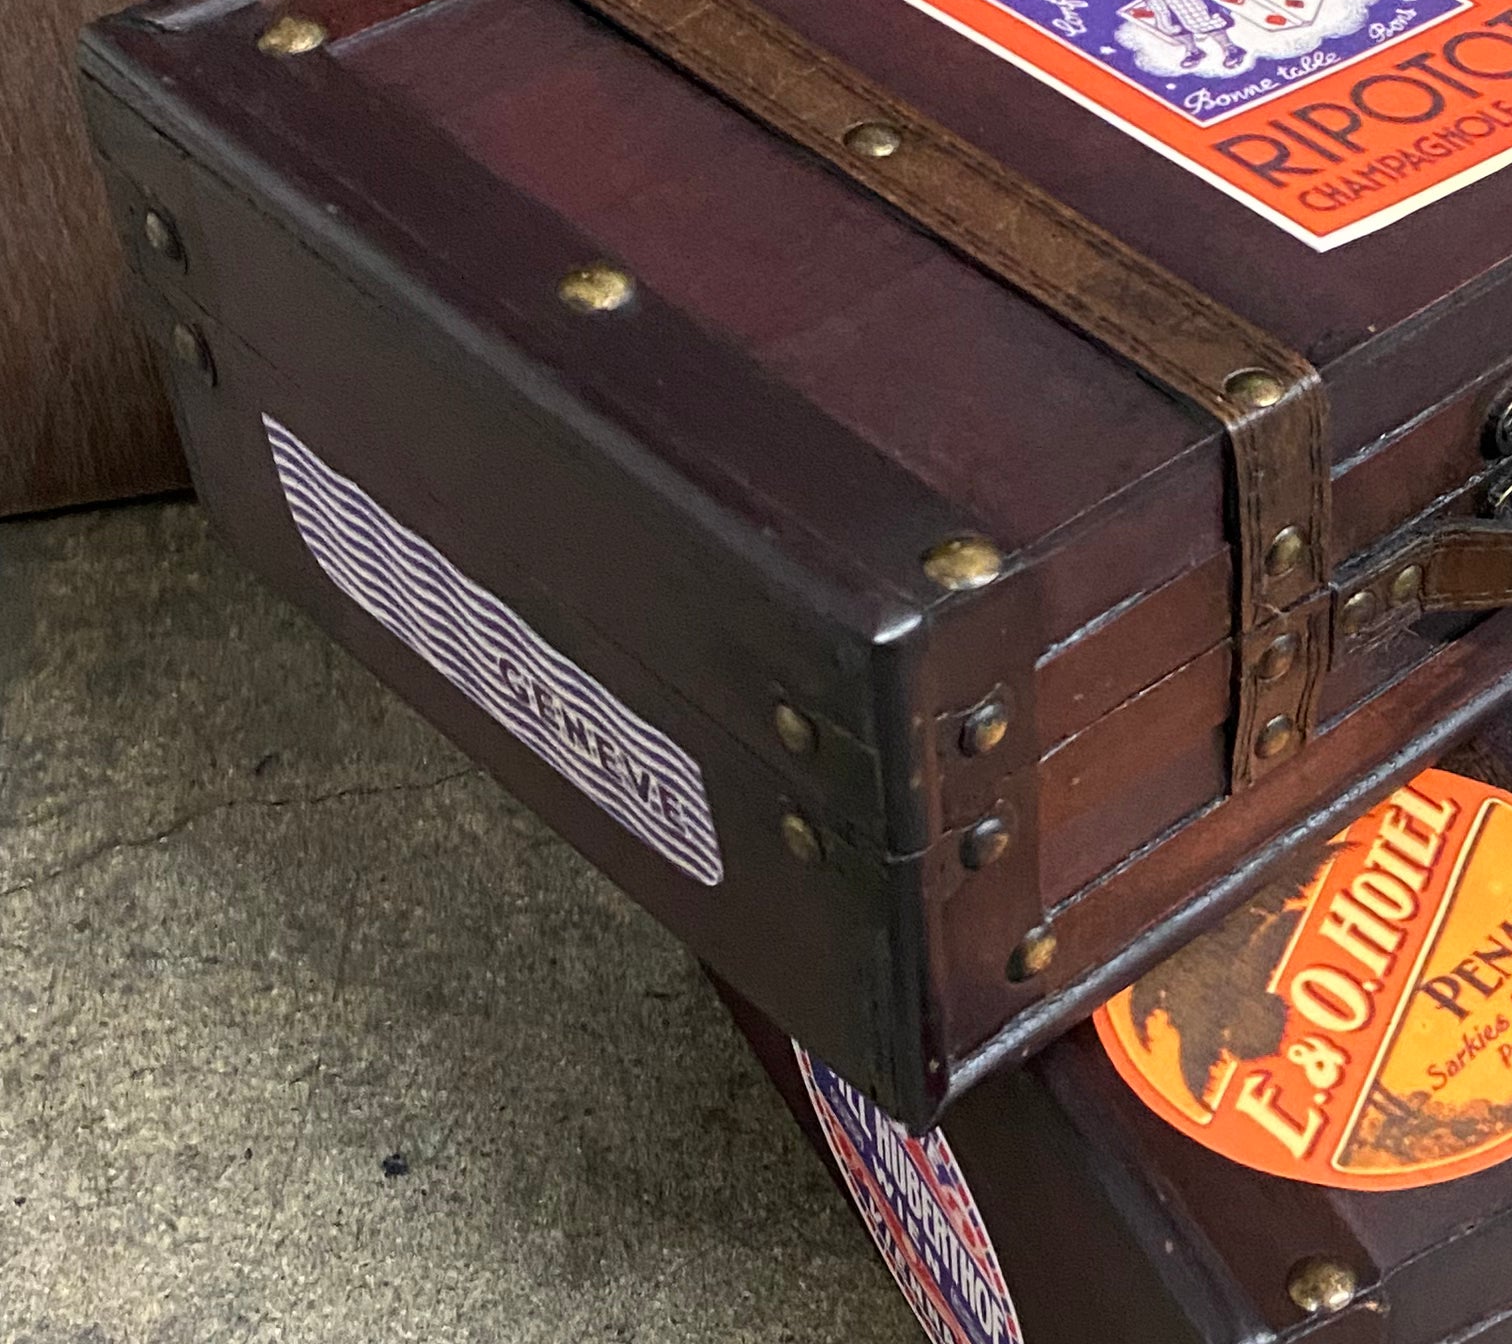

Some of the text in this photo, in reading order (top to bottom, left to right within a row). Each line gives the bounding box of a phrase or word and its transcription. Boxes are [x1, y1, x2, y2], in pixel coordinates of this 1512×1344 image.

[1367, 6, 1418, 43] Bons
[1183, 51, 1342, 115] Bonne table
[1319, 786, 1460, 973] HOTEL
[1426, 1013, 1510, 1091] Sarkies
[873, 1154, 941, 1285] WIEN
